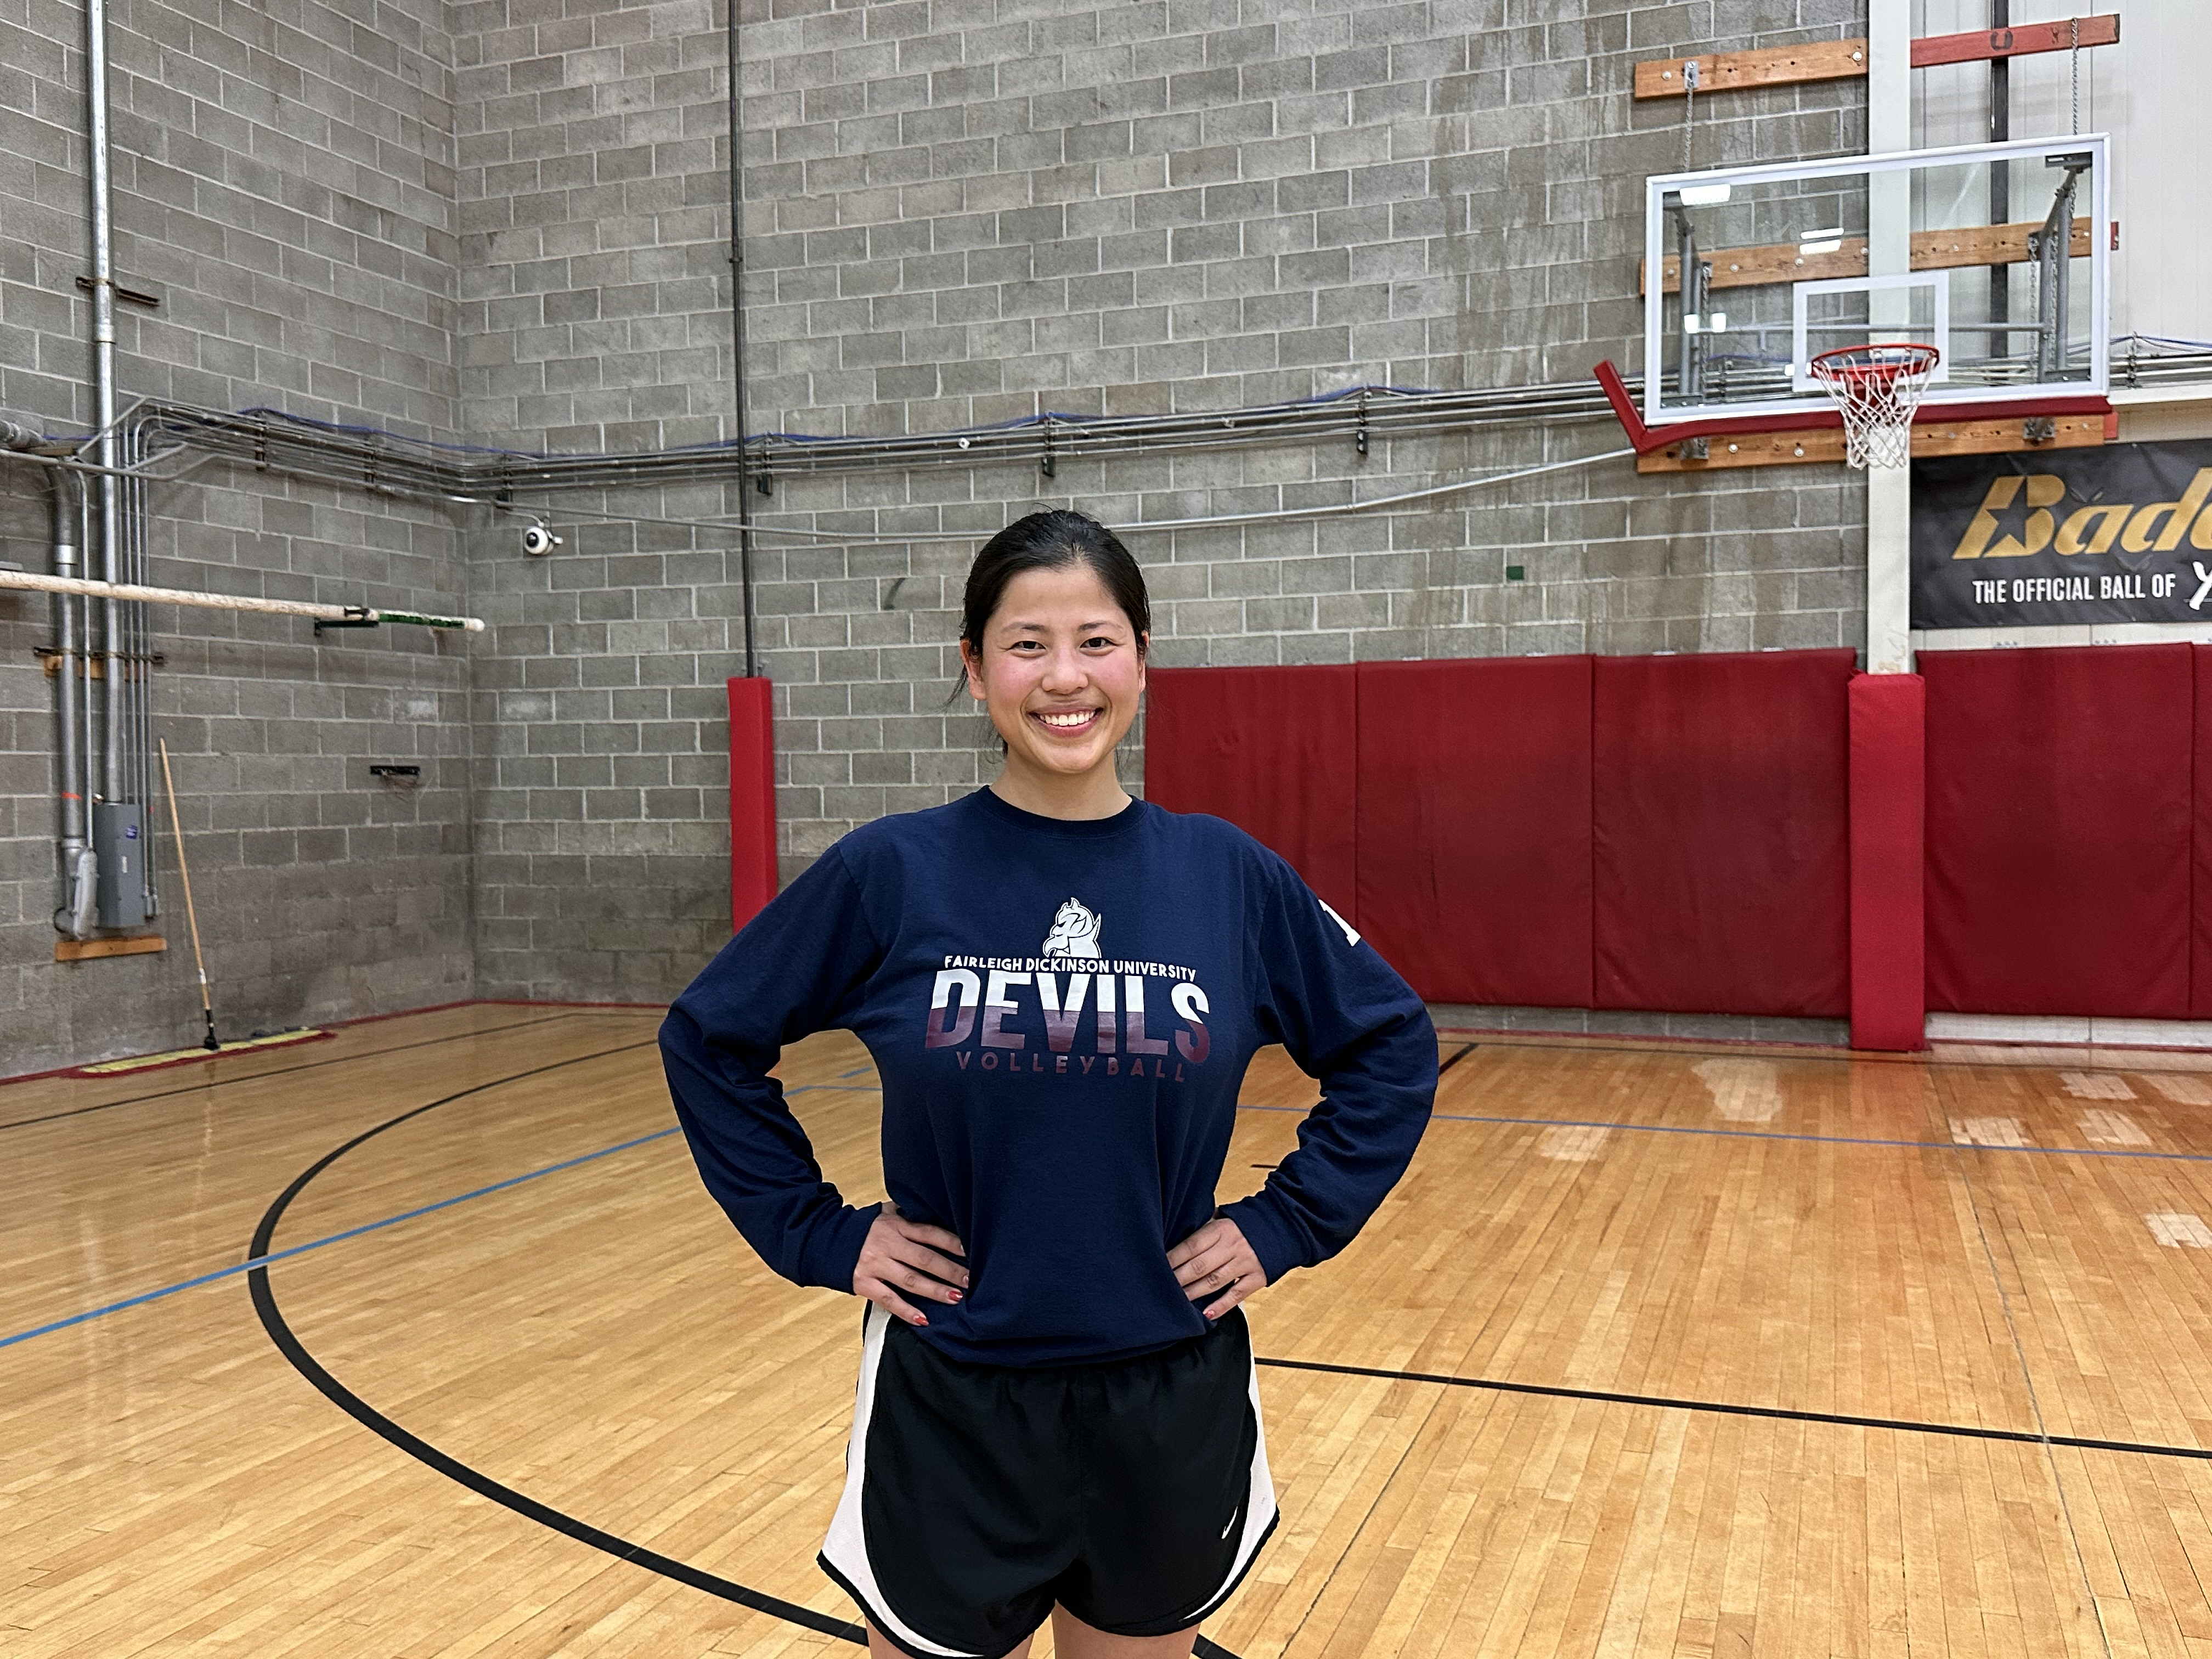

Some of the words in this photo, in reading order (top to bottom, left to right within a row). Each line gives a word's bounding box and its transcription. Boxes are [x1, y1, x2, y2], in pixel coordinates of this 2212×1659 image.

[1972, 579, 2006, 603] THE
[2012, 577, 2094, 602] OFFICIAL
[2100, 575, 2146, 600] BALL
[2151, 573, 2176, 598] OF
[944, 955, 1022, 971] FAIRLEIGH
[1025, 958, 1109, 973] DICKINSON
[1113, 961, 1197, 981] UNIVERSITY
[926, 969, 1210, 1063] DEVILS
[956, 1051, 1186, 1082] VOLLEYBALL
